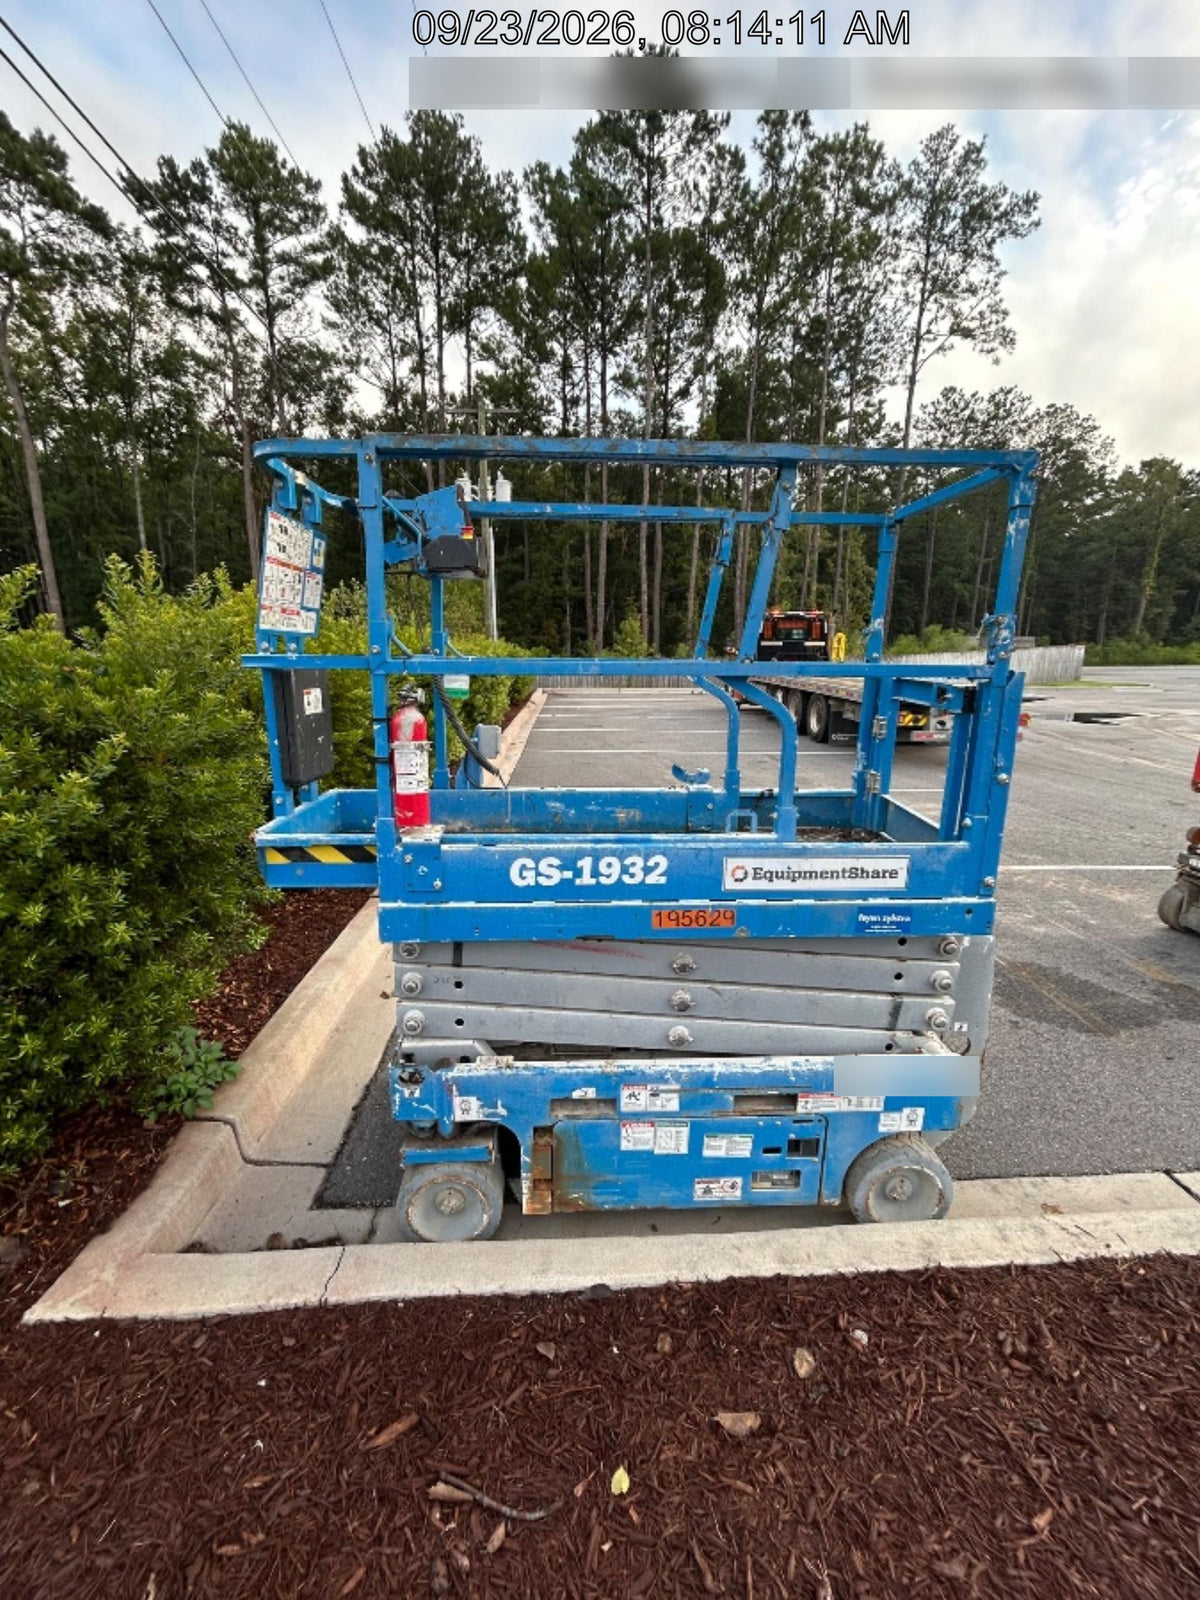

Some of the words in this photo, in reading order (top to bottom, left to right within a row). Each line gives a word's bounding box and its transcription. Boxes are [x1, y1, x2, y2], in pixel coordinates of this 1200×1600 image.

[509, 854, 669, 887] GS-1932
[751, 865, 900, 883] EquipmentShare
[655, 909, 735, 928] 195629
